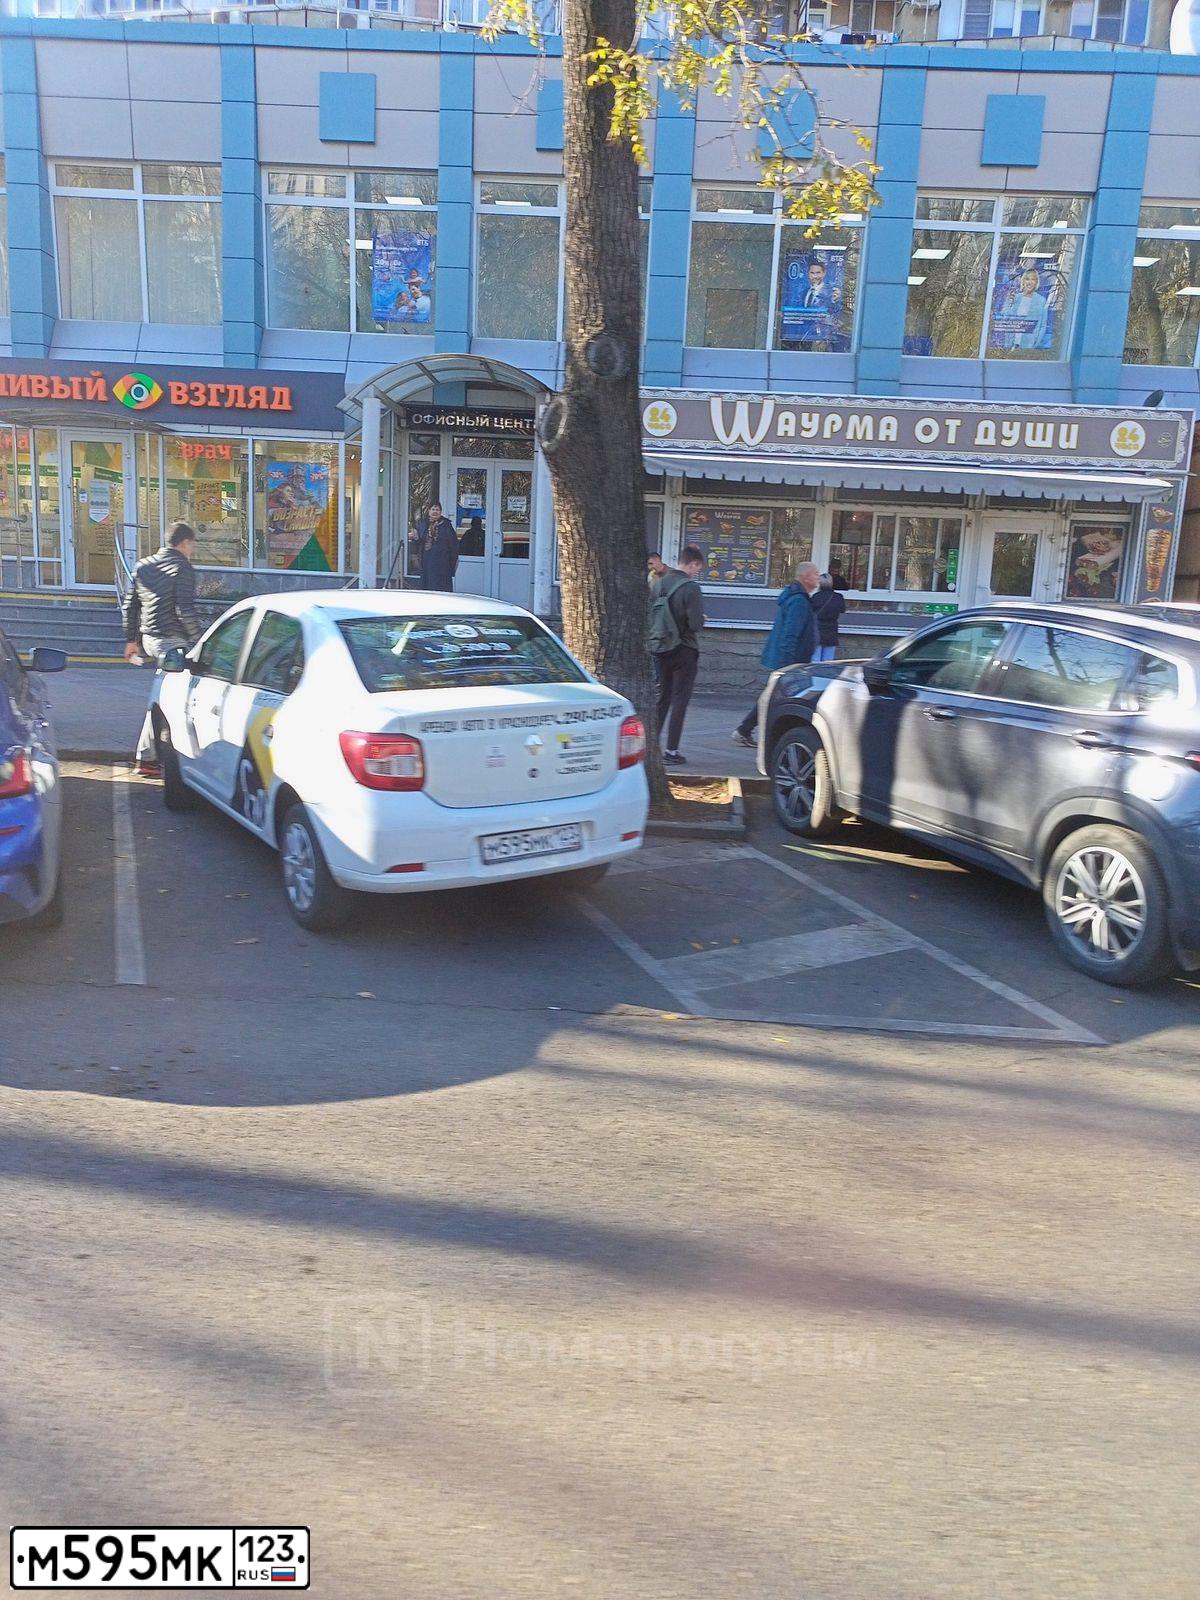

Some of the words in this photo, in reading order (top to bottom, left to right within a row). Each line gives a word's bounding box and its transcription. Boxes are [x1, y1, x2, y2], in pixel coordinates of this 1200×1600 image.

[168, 381, 294, 412] ВЗГЛЯД
[412, 413, 490, 427] ОФИСНЫЙ
[914, 417, 963, 444] ОТ
[974, 418, 1080, 450] ДУШИ
